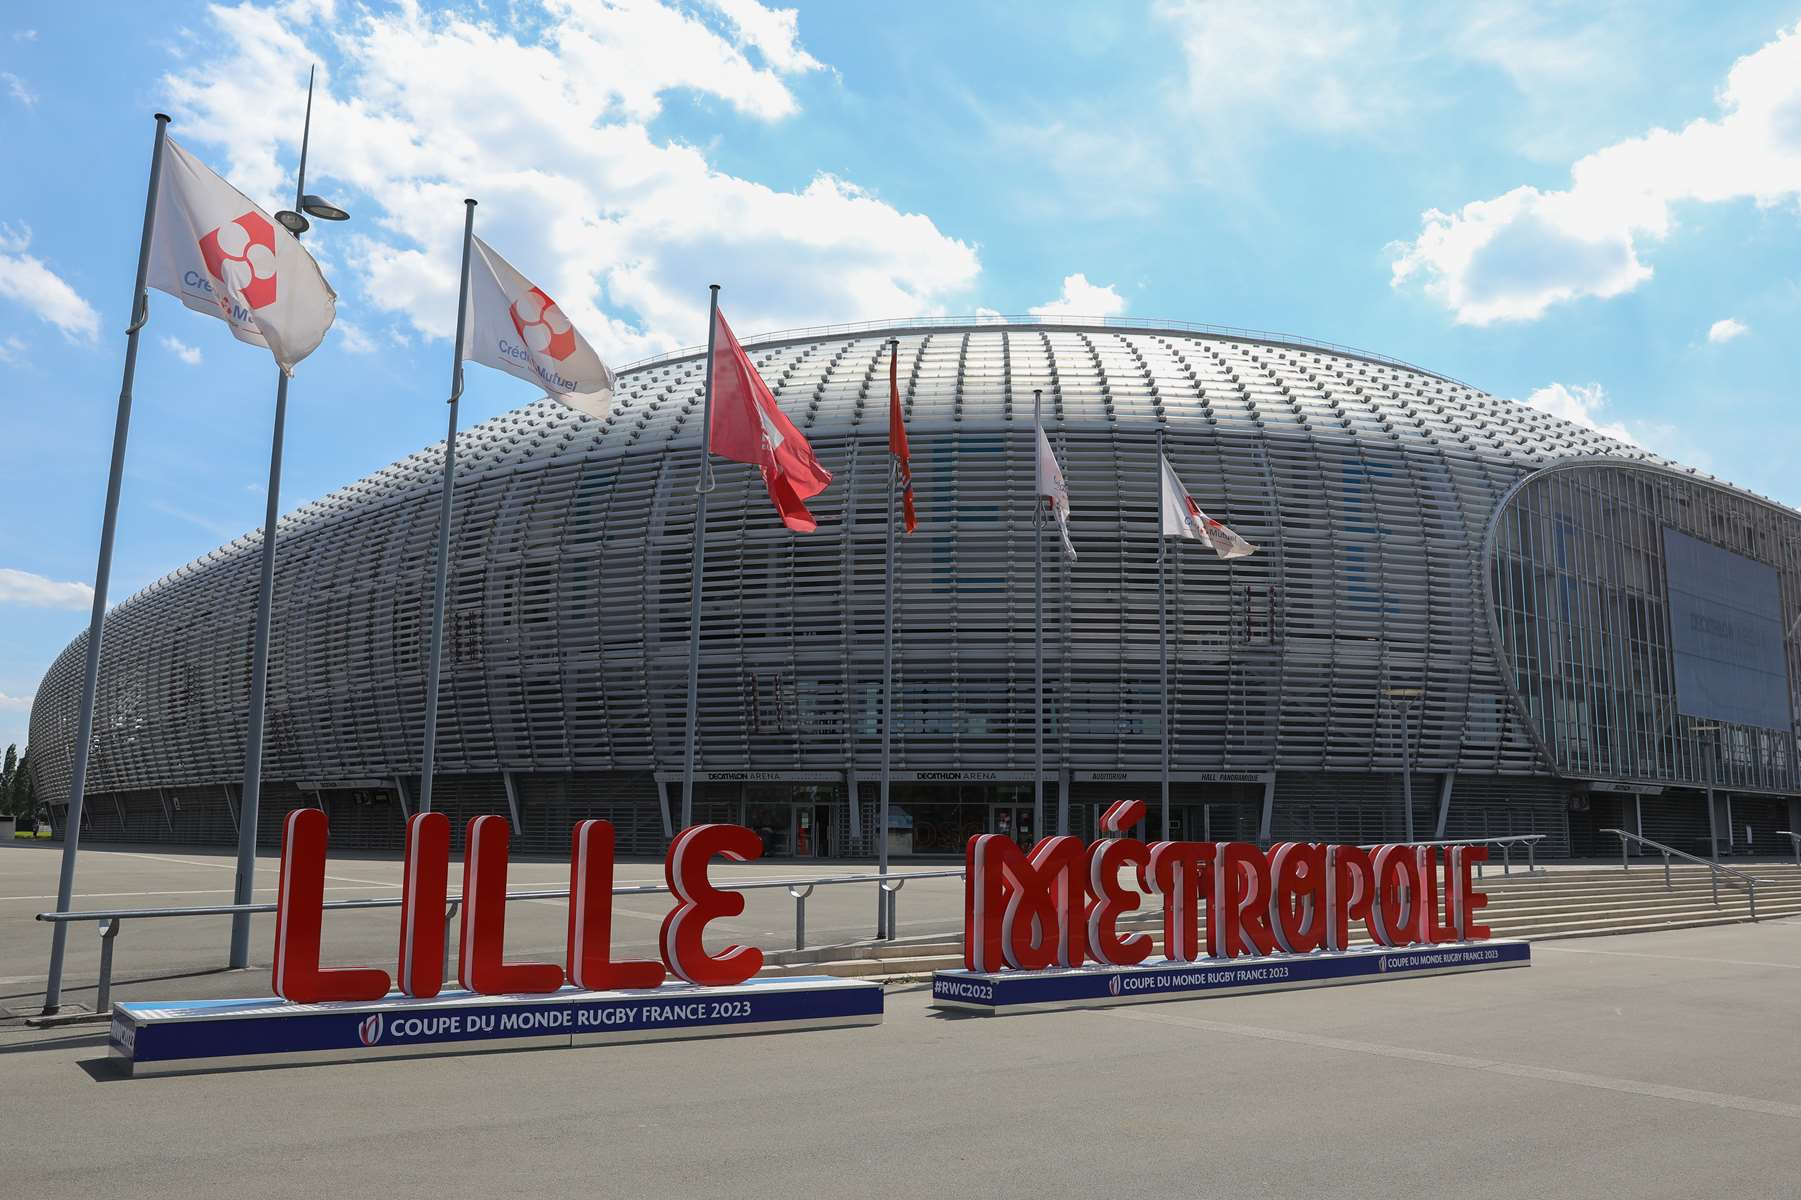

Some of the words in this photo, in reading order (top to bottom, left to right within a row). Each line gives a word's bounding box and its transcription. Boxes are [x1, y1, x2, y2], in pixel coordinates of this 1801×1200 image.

[707, 772, 748, 780] DECATHLON
[750, 772, 780, 780] ARENA
[916, 772, 961, 780] DECATHLON
[963, 772, 996, 780] ARENA
[1201, 773, 1216, 781] HALL
[271, 807, 765, 1003] LILLE
[1388, 957, 1409, 968] COUPE
[1410, 956, 1419, 965] DU
[1420, 954, 1442, 965] MONDE
[1443, 953, 1462, 963] RUGBY
[1463, 951, 1484, 961] FRANCE
[1485, 950, 1499, 959] 2023
[1123, 977, 1155, 990] COUPE
[1157, 975, 1171, 987] DU
[1172, 973, 1206, 986] MONDE
[1207, 971, 1236, 983] RUGBY
[1237, 968, 1267, 981] FRANCE
[1269, 967, 1289, 978] 2023
[934, 980, 993, 1000] #RWC2023
[390, 1016, 461, 1037] COUPE
[466, 1014, 495, 1033] DU
[500, 1010, 573, 1030] MONDE
[577, 1007, 637, 1026] RUGBY
[642, 1003, 707, 1022] FRANCE
[710, 1001, 752, 1018] 2023
